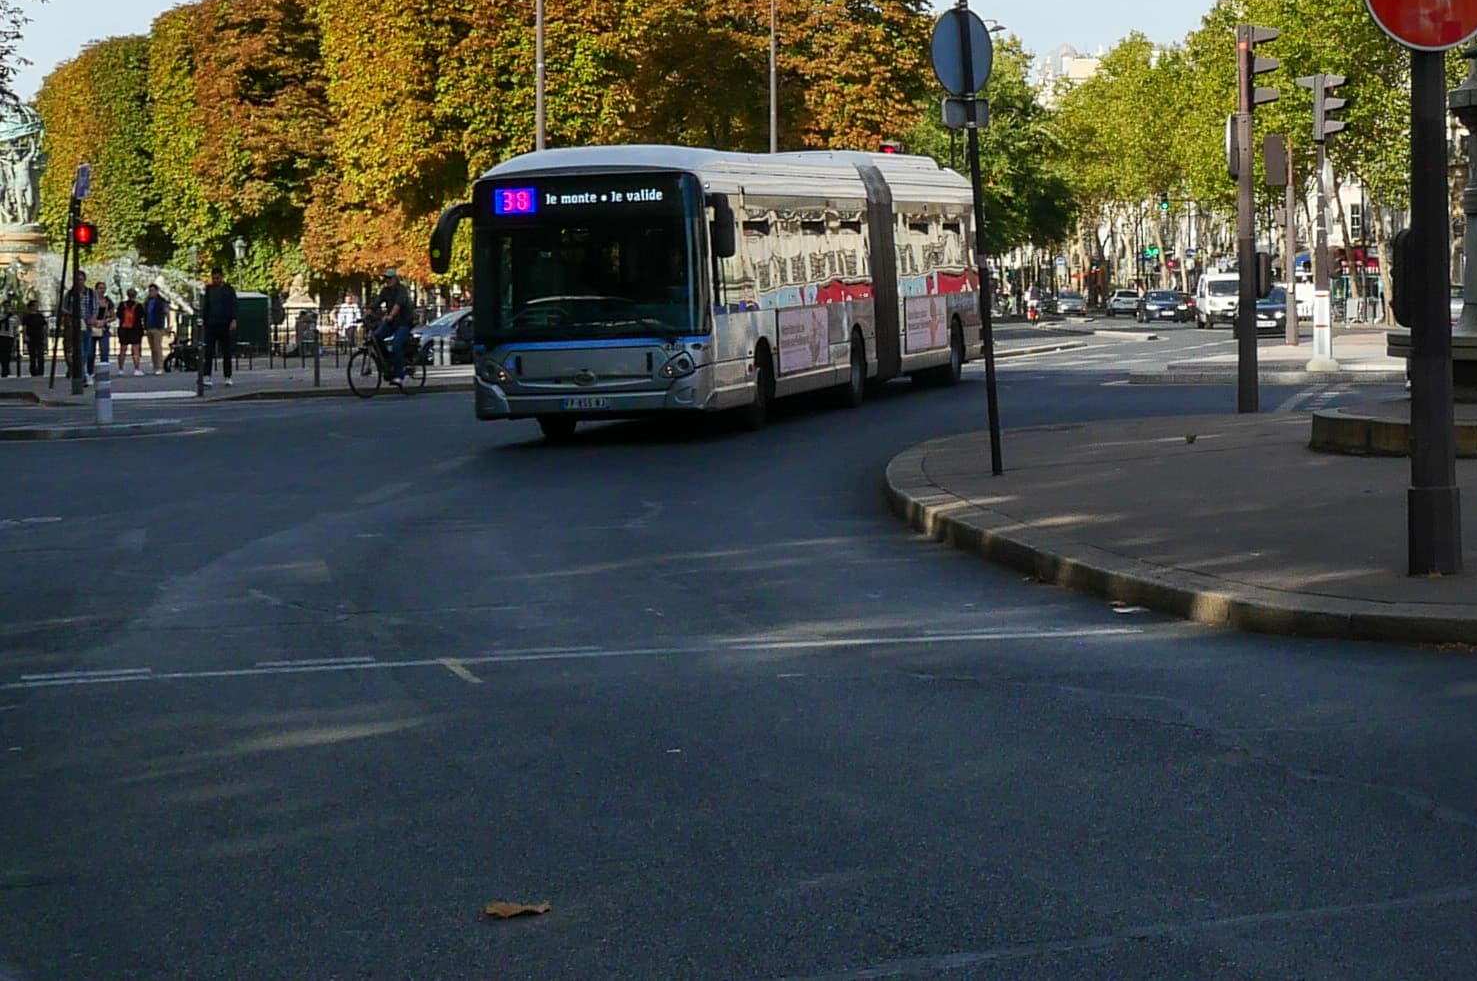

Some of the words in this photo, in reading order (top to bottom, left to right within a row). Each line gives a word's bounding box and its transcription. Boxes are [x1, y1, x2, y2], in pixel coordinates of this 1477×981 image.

[502, 190, 530, 212] 38
[545, 193, 557, 204] Je
[561, 192, 598, 204] monte
[611, 190, 623, 202] Je
[626, 188, 663, 201] valide
